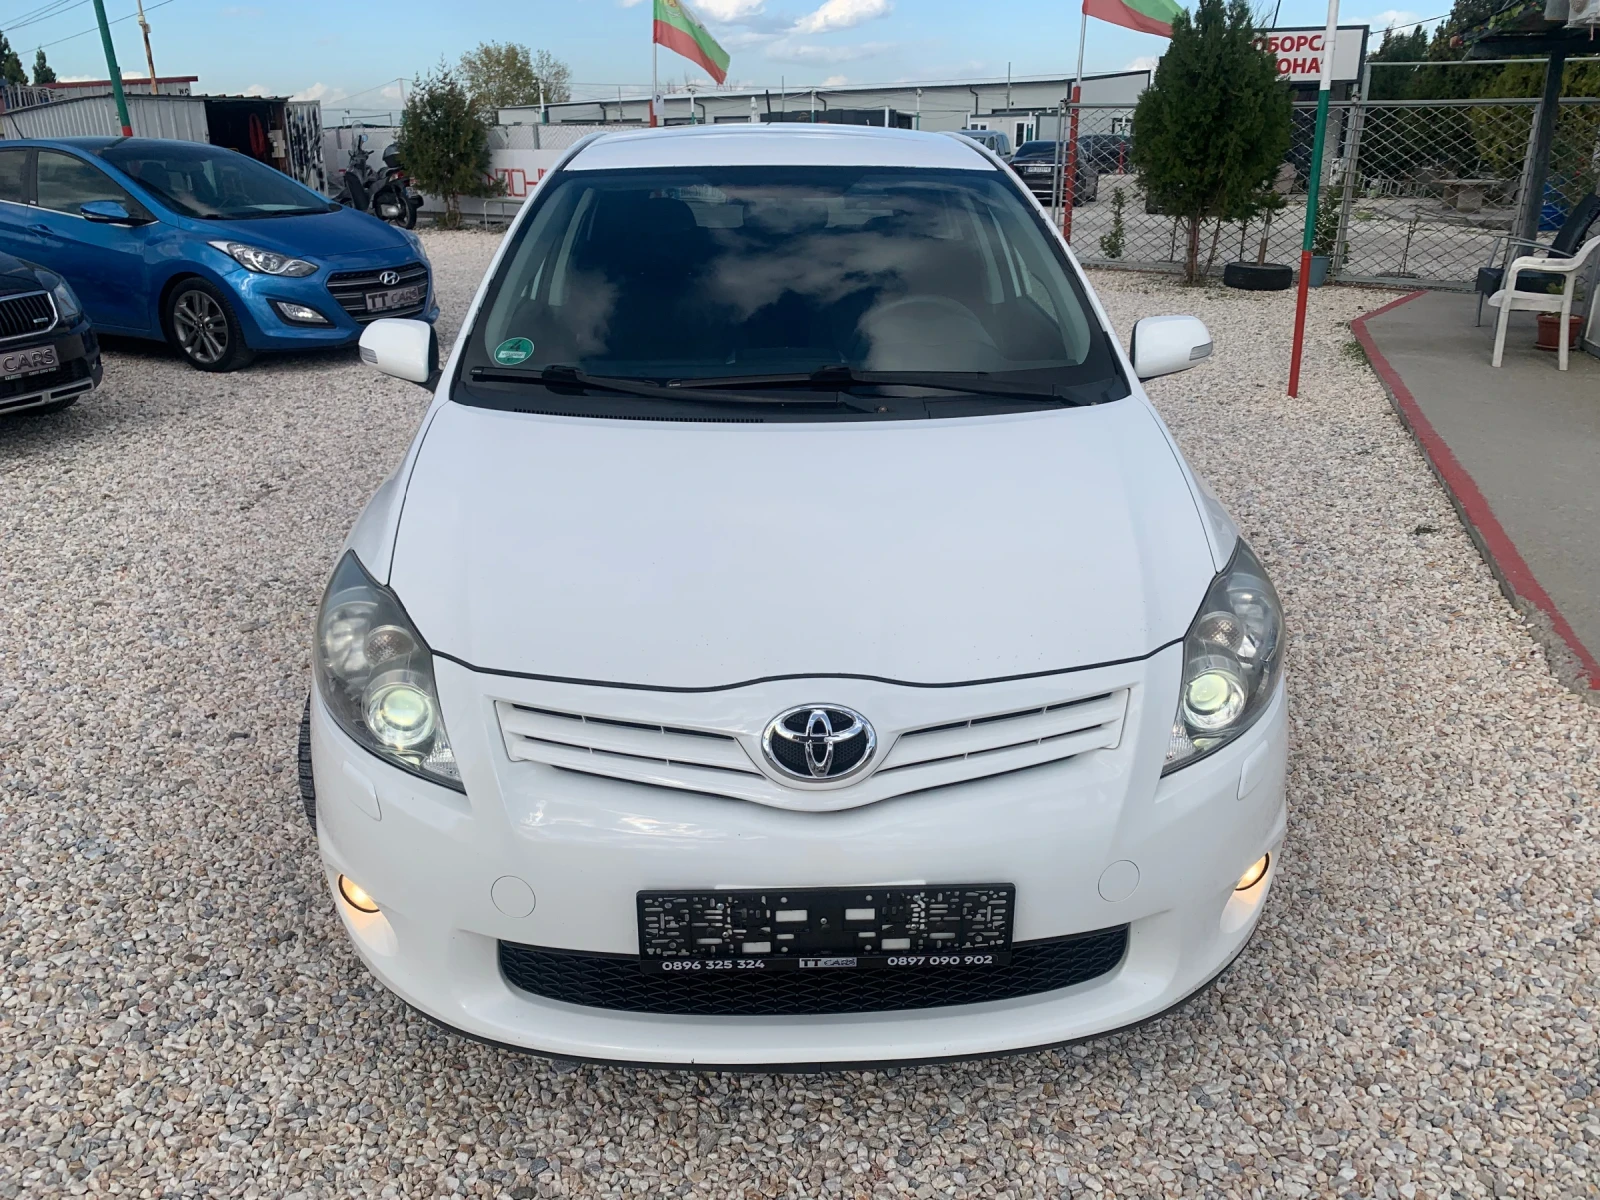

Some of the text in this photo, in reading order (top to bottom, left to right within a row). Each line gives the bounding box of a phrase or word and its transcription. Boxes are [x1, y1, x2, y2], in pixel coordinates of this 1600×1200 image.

[1251, 35, 1327, 53] ОБОРС
[367, 292, 389, 309] TT
[391, 287, 418, 304] CARS
[3, 349, 56, 372] CARS
[661, 959, 766, 971] 0896 325 324
[801, 958, 856, 967] TT CARS
[887, 955, 993, 966] 0897 090 902
